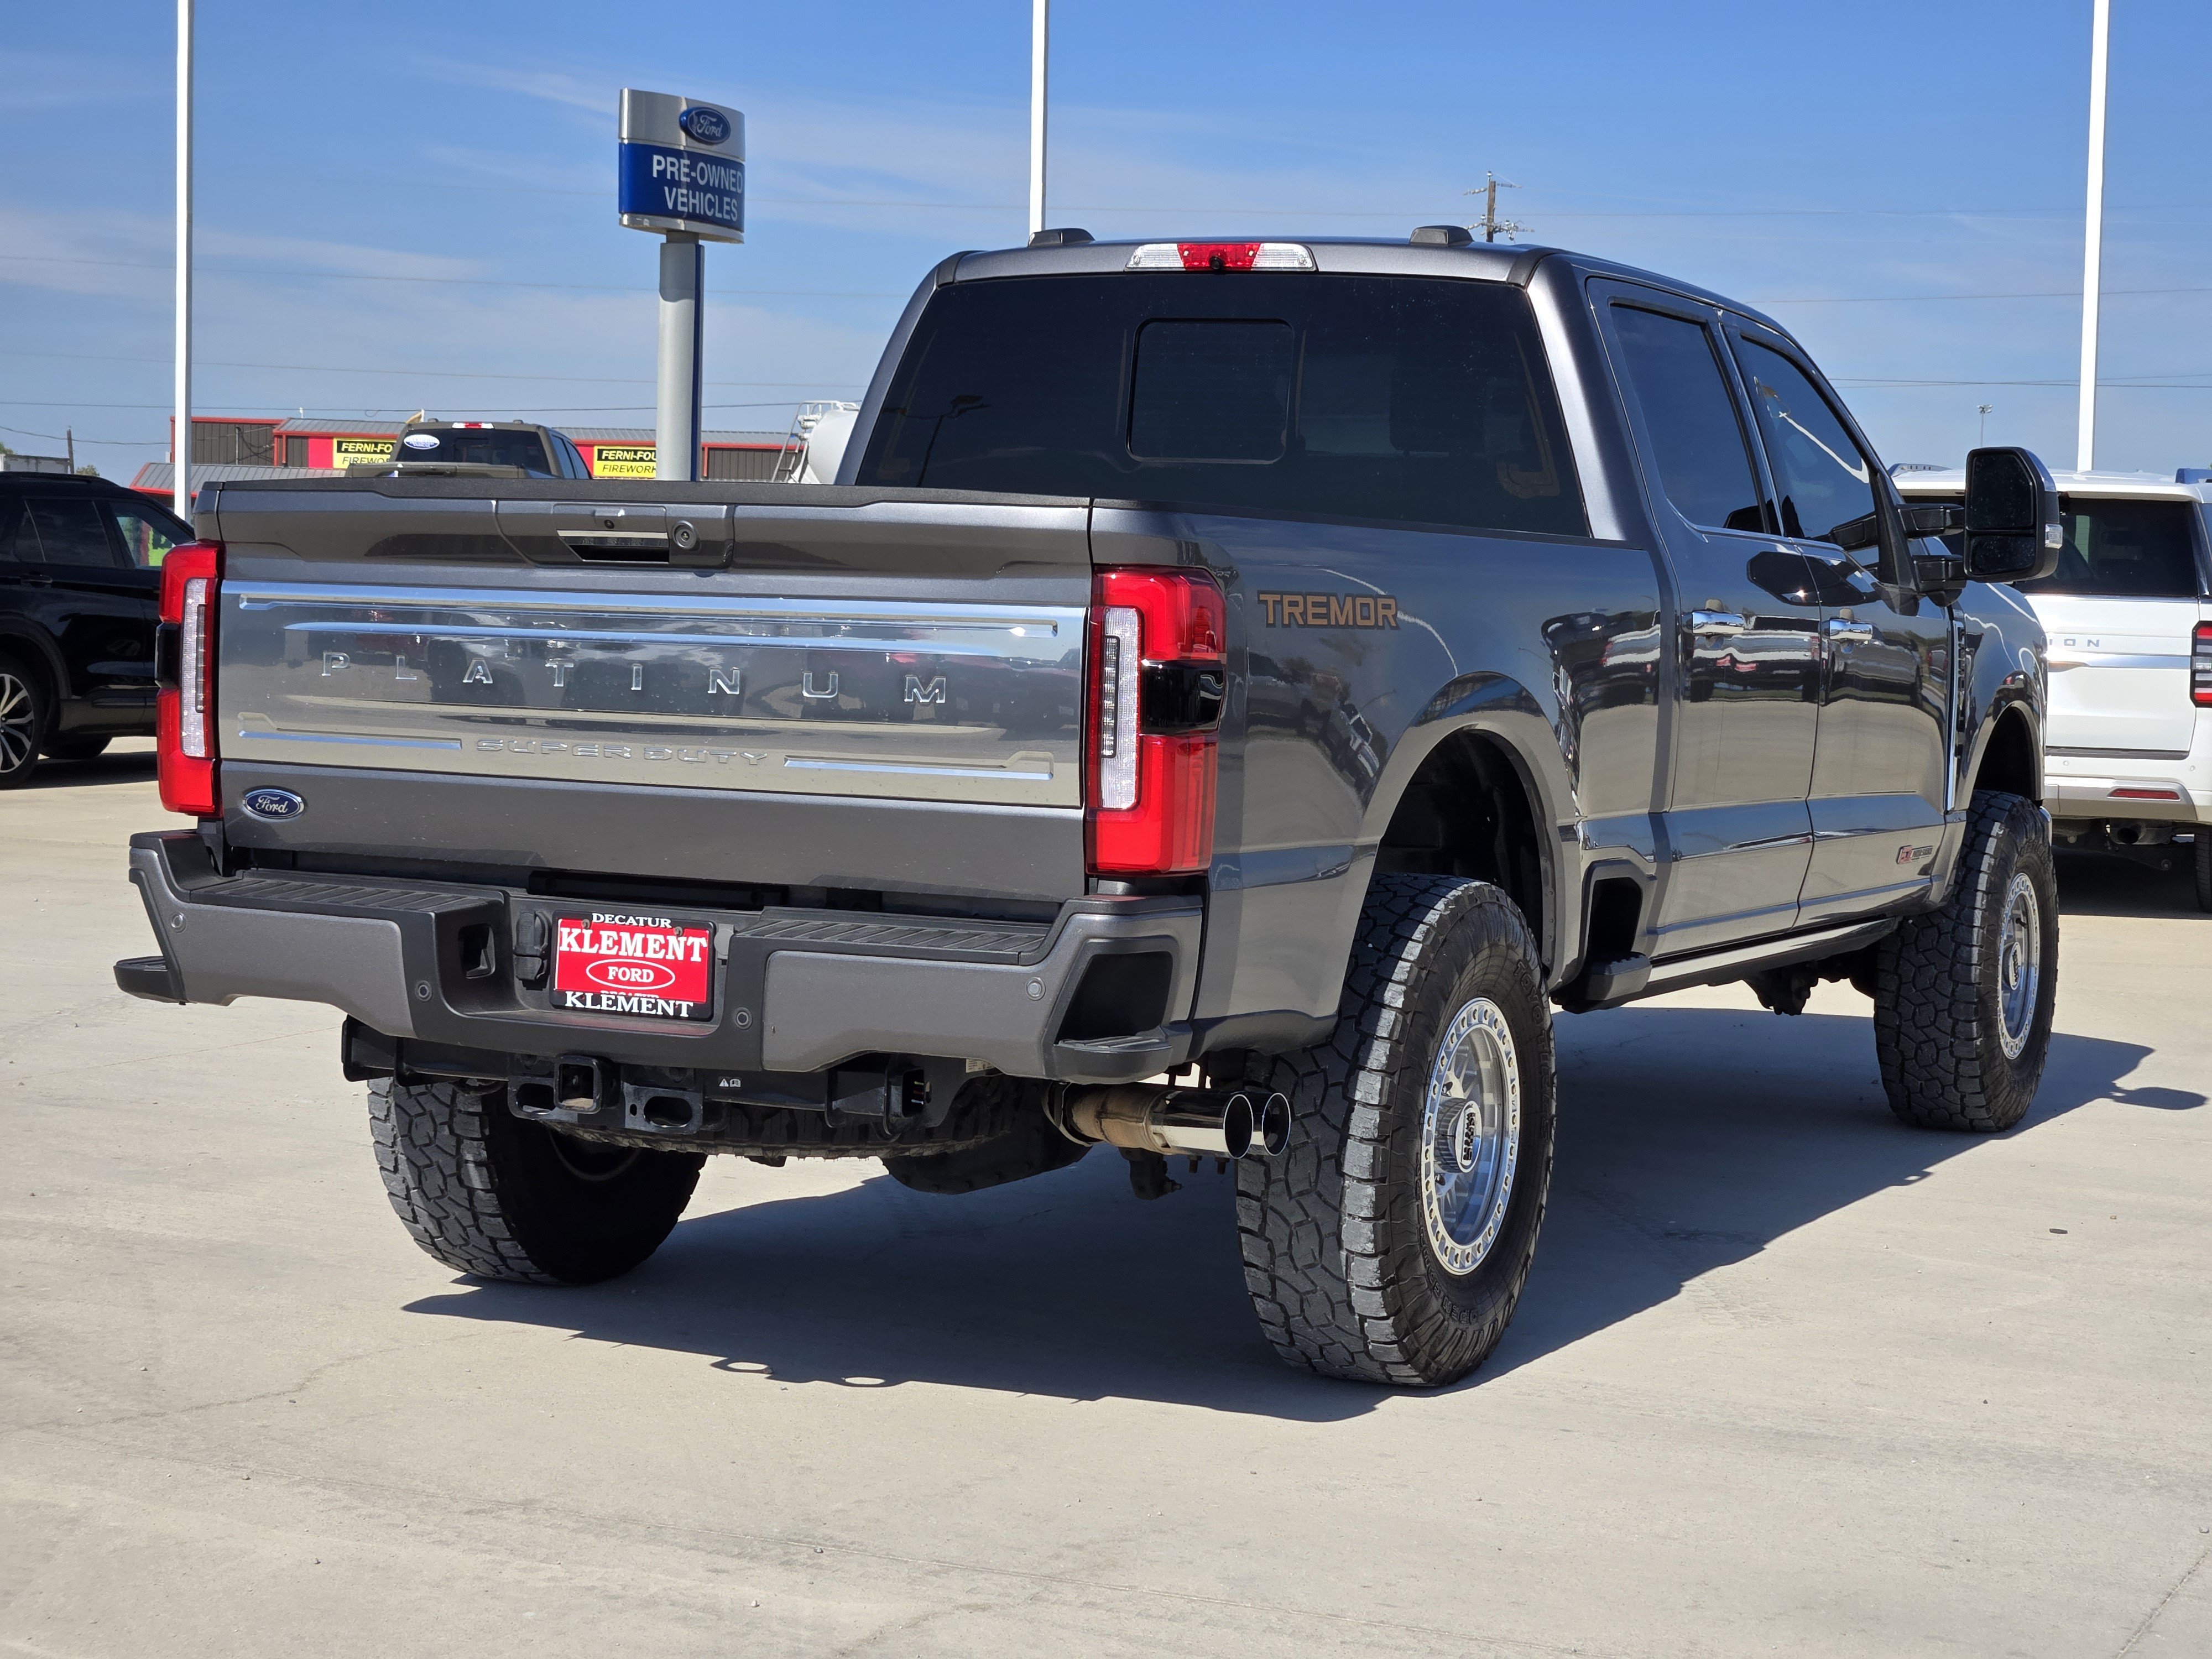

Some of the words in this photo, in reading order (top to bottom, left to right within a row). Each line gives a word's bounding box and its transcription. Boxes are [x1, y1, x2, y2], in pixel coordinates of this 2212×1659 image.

[697, 114, 723, 137] Ford
[653, 154, 743, 194] PRE-OWNED
[664, 186, 738, 221] VEHICLES
[1258, 592, 1399, 628] TREMOR
[321, 651, 947, 703] PLATINUM
[476, 739, 631, 758] SUPER
[644, 747, 768, 765] DUTY
[255, 795, 289, 813] Ford
[592, 913, 672, 928] DECATUR
[559, 927, 708, 962] KLEMENT
[607, 966, 655, 983] FORD
[565, 990, 694, 1018] KLEMENT
